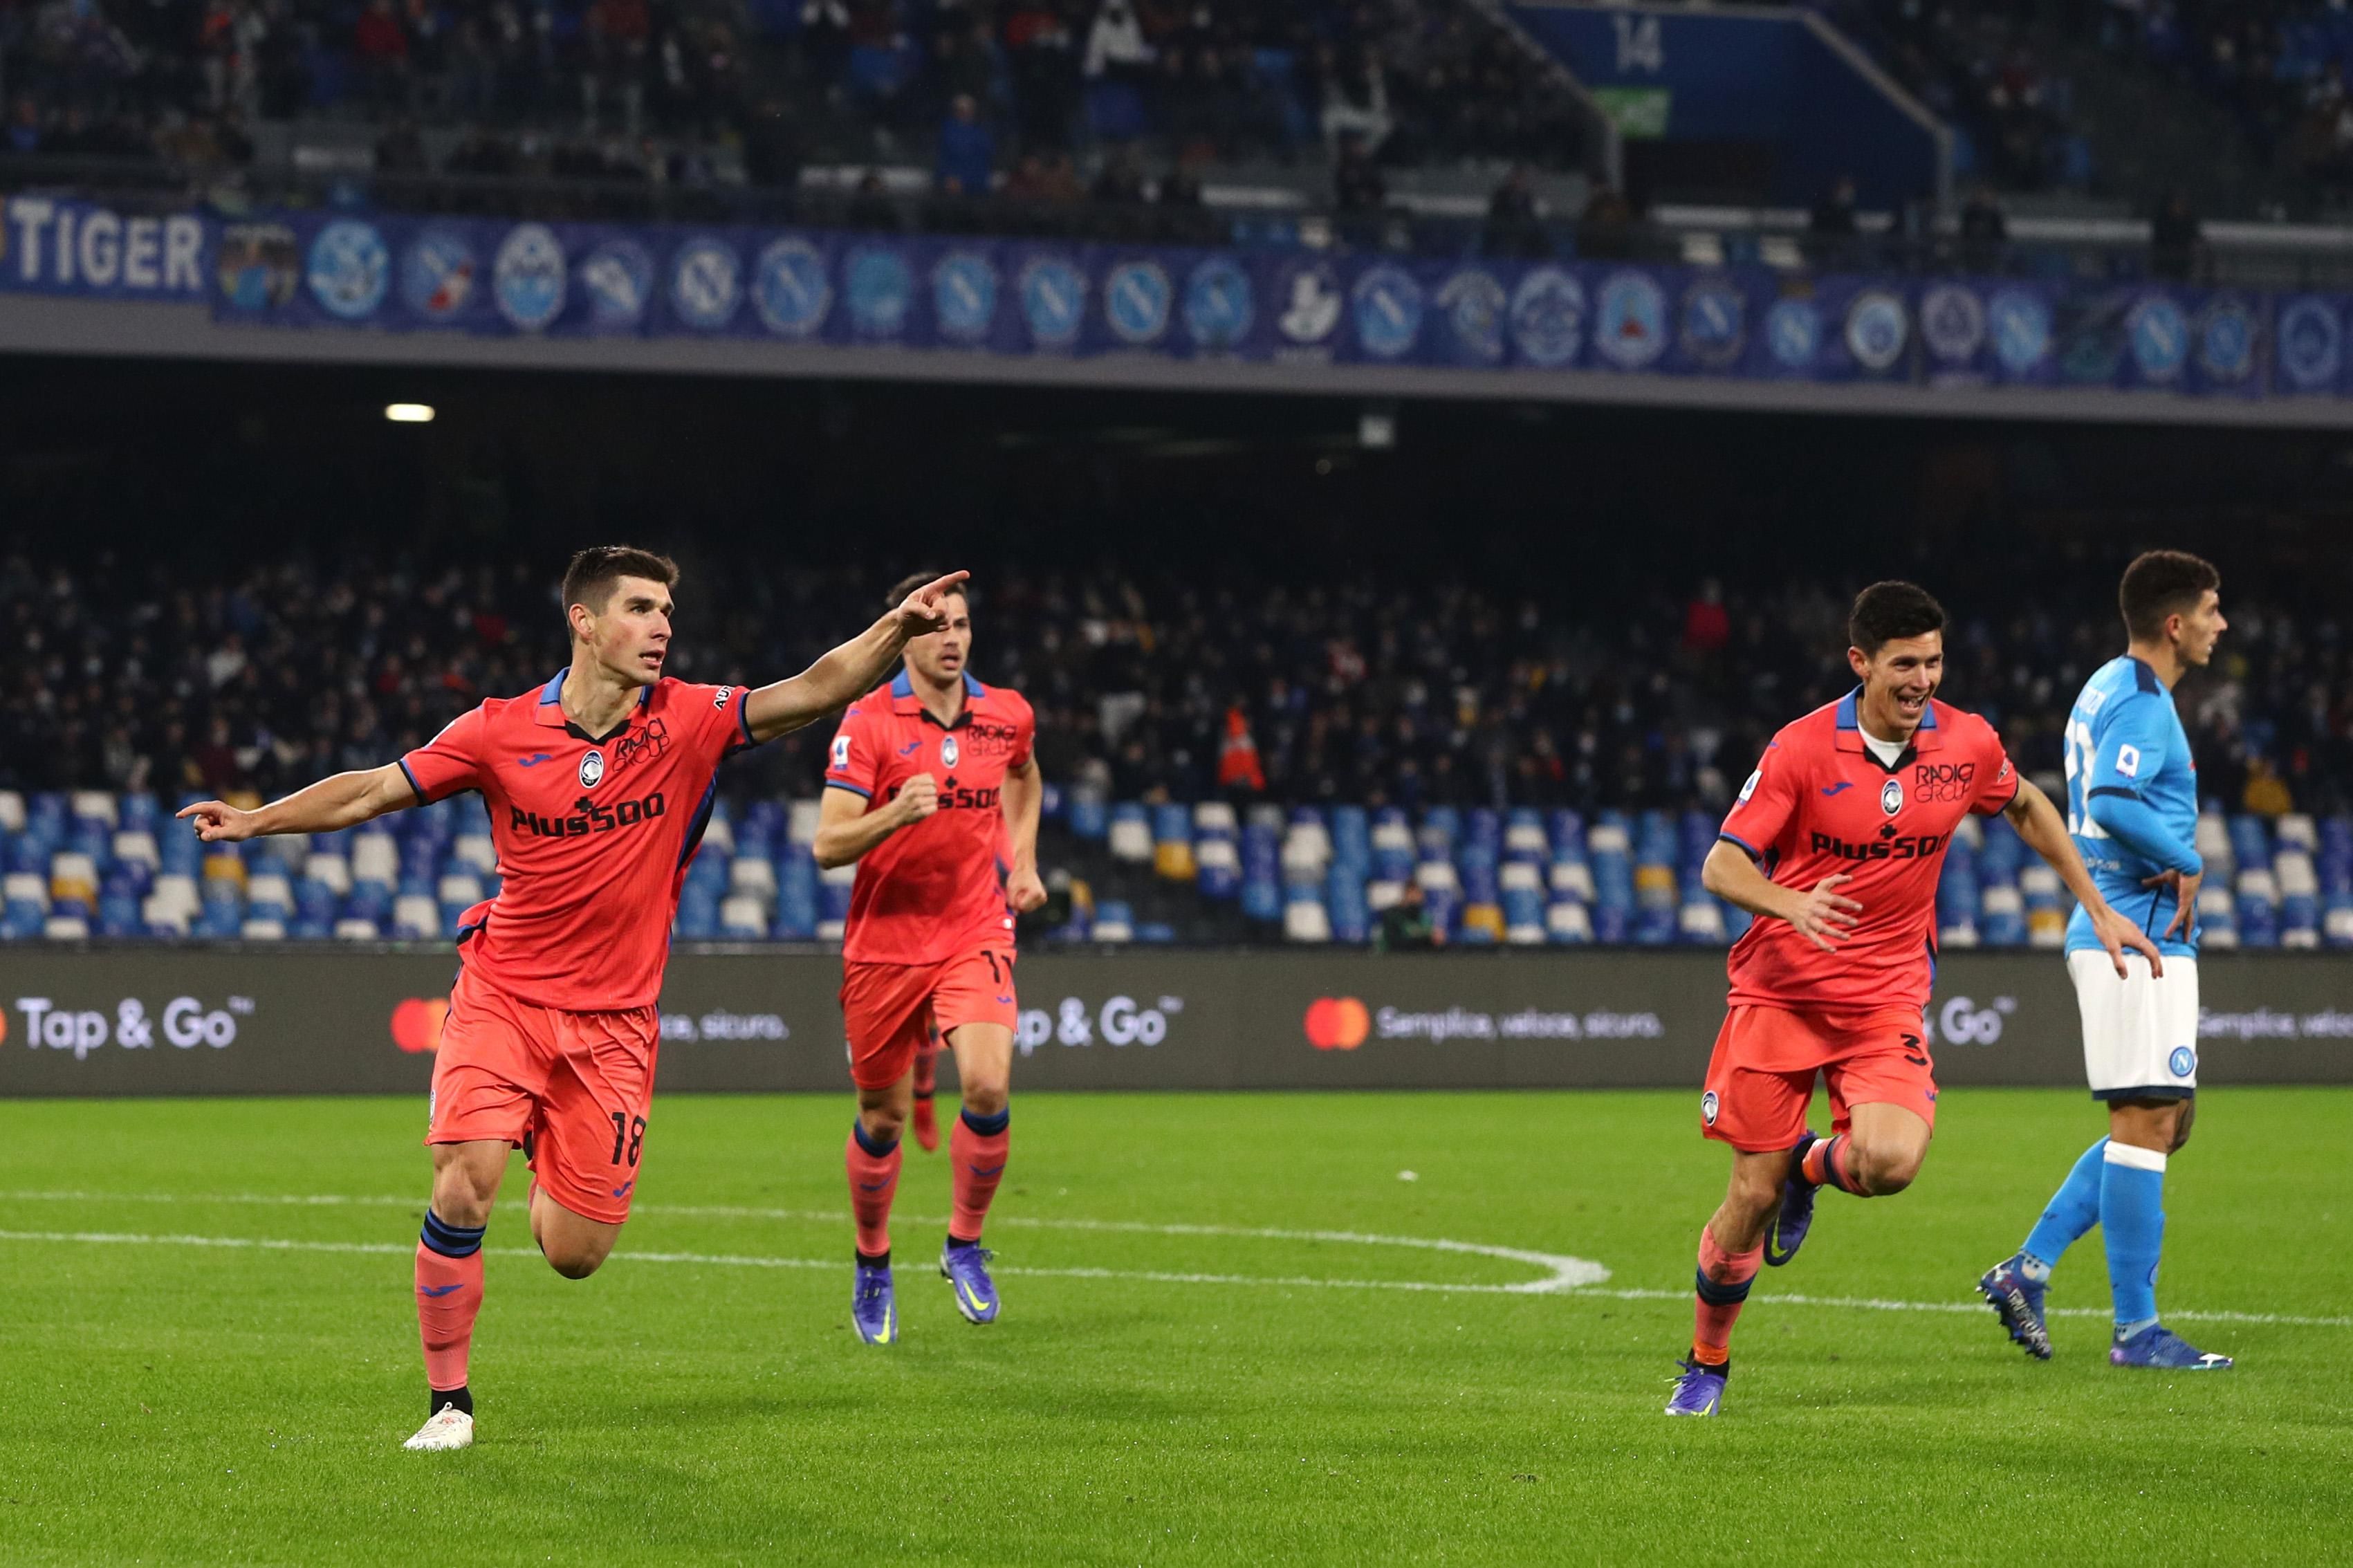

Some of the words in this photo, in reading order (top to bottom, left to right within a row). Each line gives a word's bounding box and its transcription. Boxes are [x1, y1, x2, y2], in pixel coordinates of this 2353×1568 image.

[1614, 14, 1663, 72] 14
[10, 200, 203, 289] TIGER
[510, 792, 665, 838] Plus500
[15, 997, 108, 1060] Tap
[116, 997, 153, 1049] &
[1057, 997, 1093, 1046] &
[611, 1112, 646, 1168] 18
